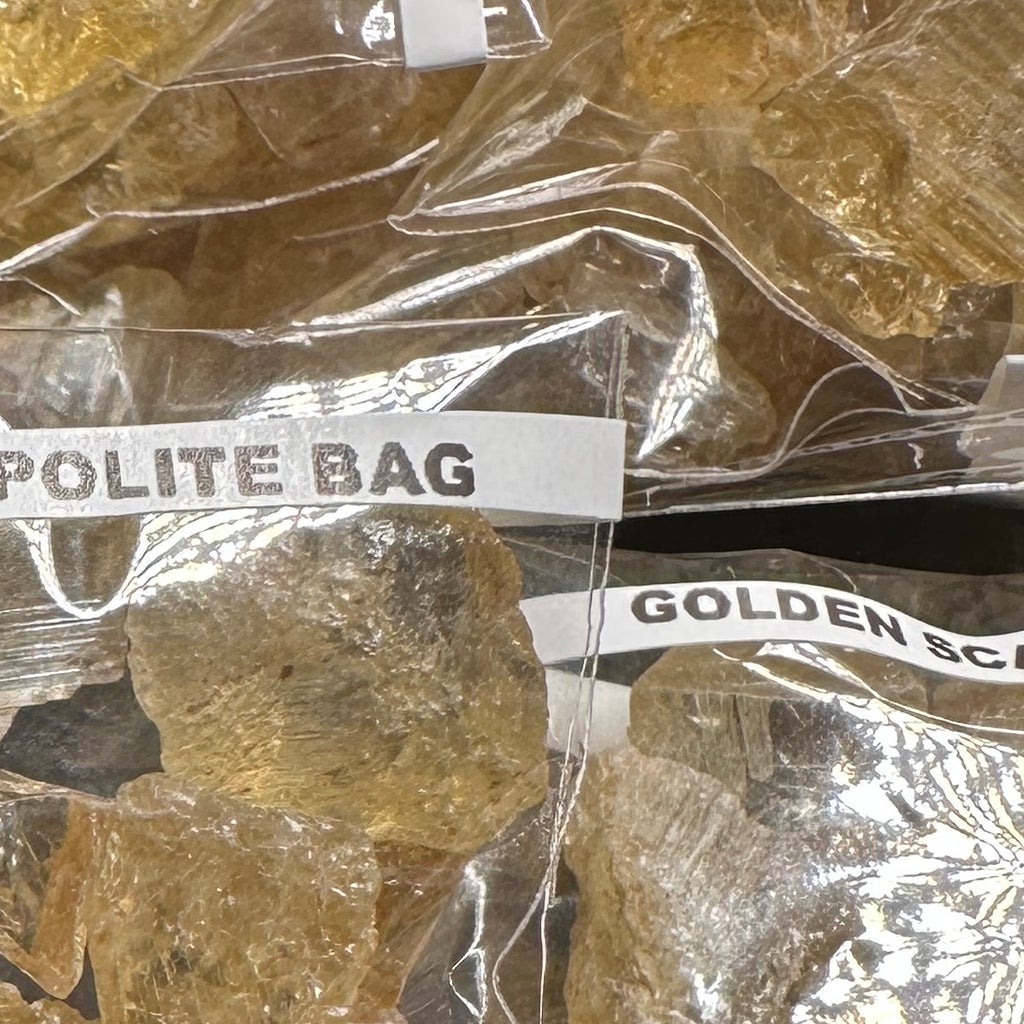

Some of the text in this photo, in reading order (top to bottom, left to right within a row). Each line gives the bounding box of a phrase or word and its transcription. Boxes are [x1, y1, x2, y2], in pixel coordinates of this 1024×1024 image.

[311, 442, 476, 497] BAG
[631, 587, 1024, 670] GOLDEN SC
